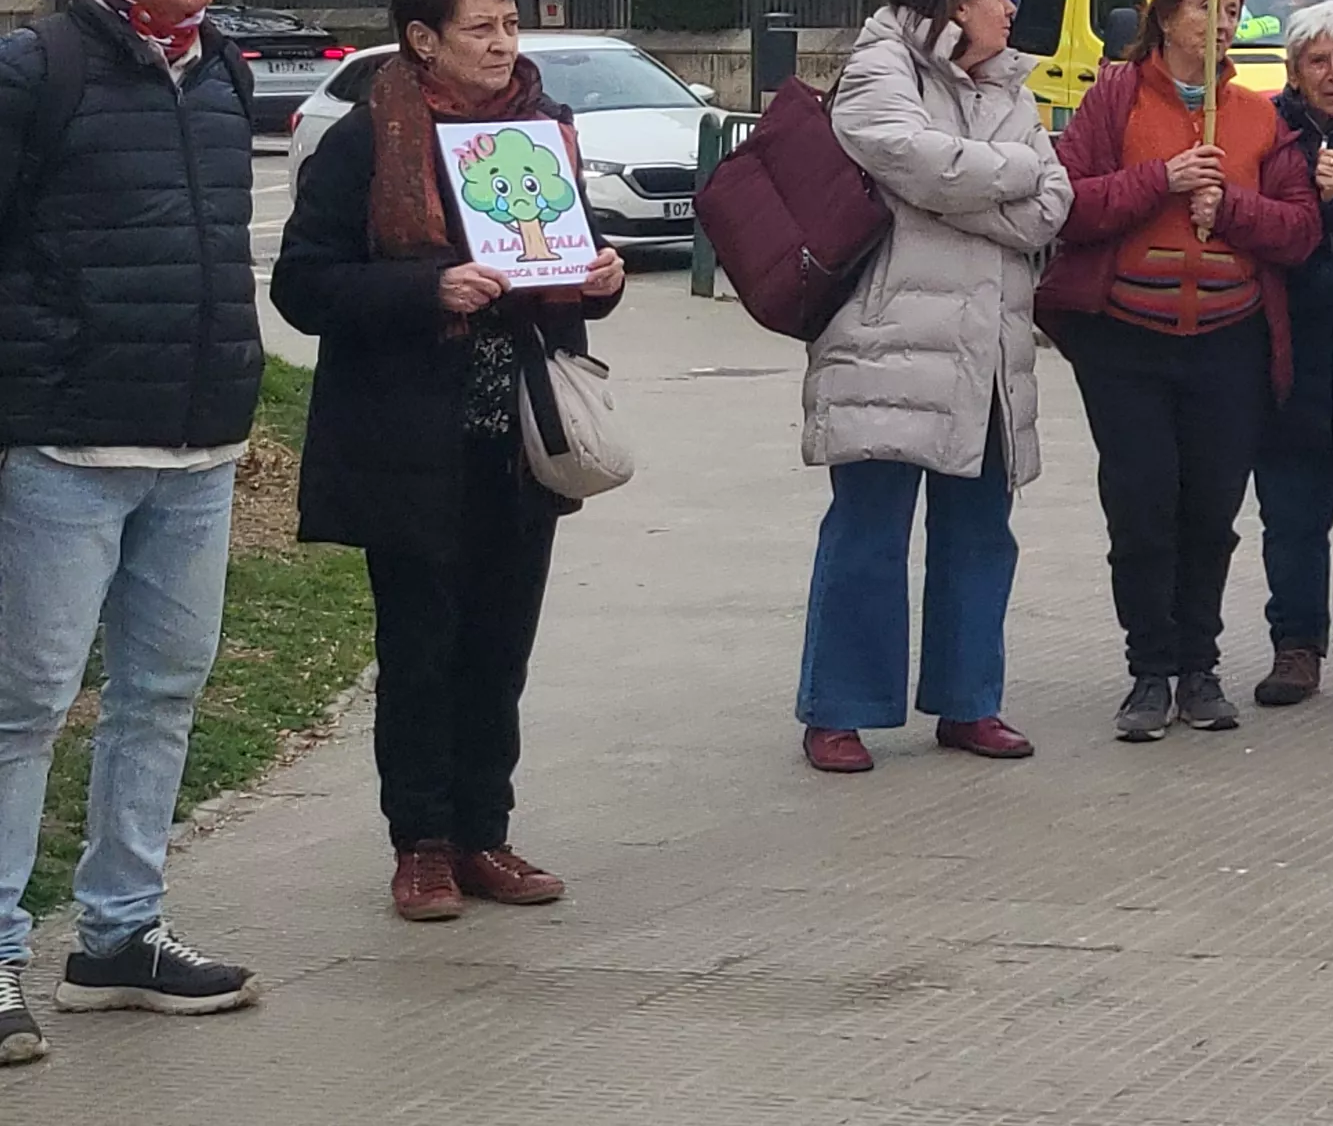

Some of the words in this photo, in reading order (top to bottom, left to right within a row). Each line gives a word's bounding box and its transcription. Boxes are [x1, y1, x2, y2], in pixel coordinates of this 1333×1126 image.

[451, 132, 496, 171] NO
[481, 240, 495, 253] A
[498, 237, 522, 252] LA
[545, 234, 589, 249] TALA
